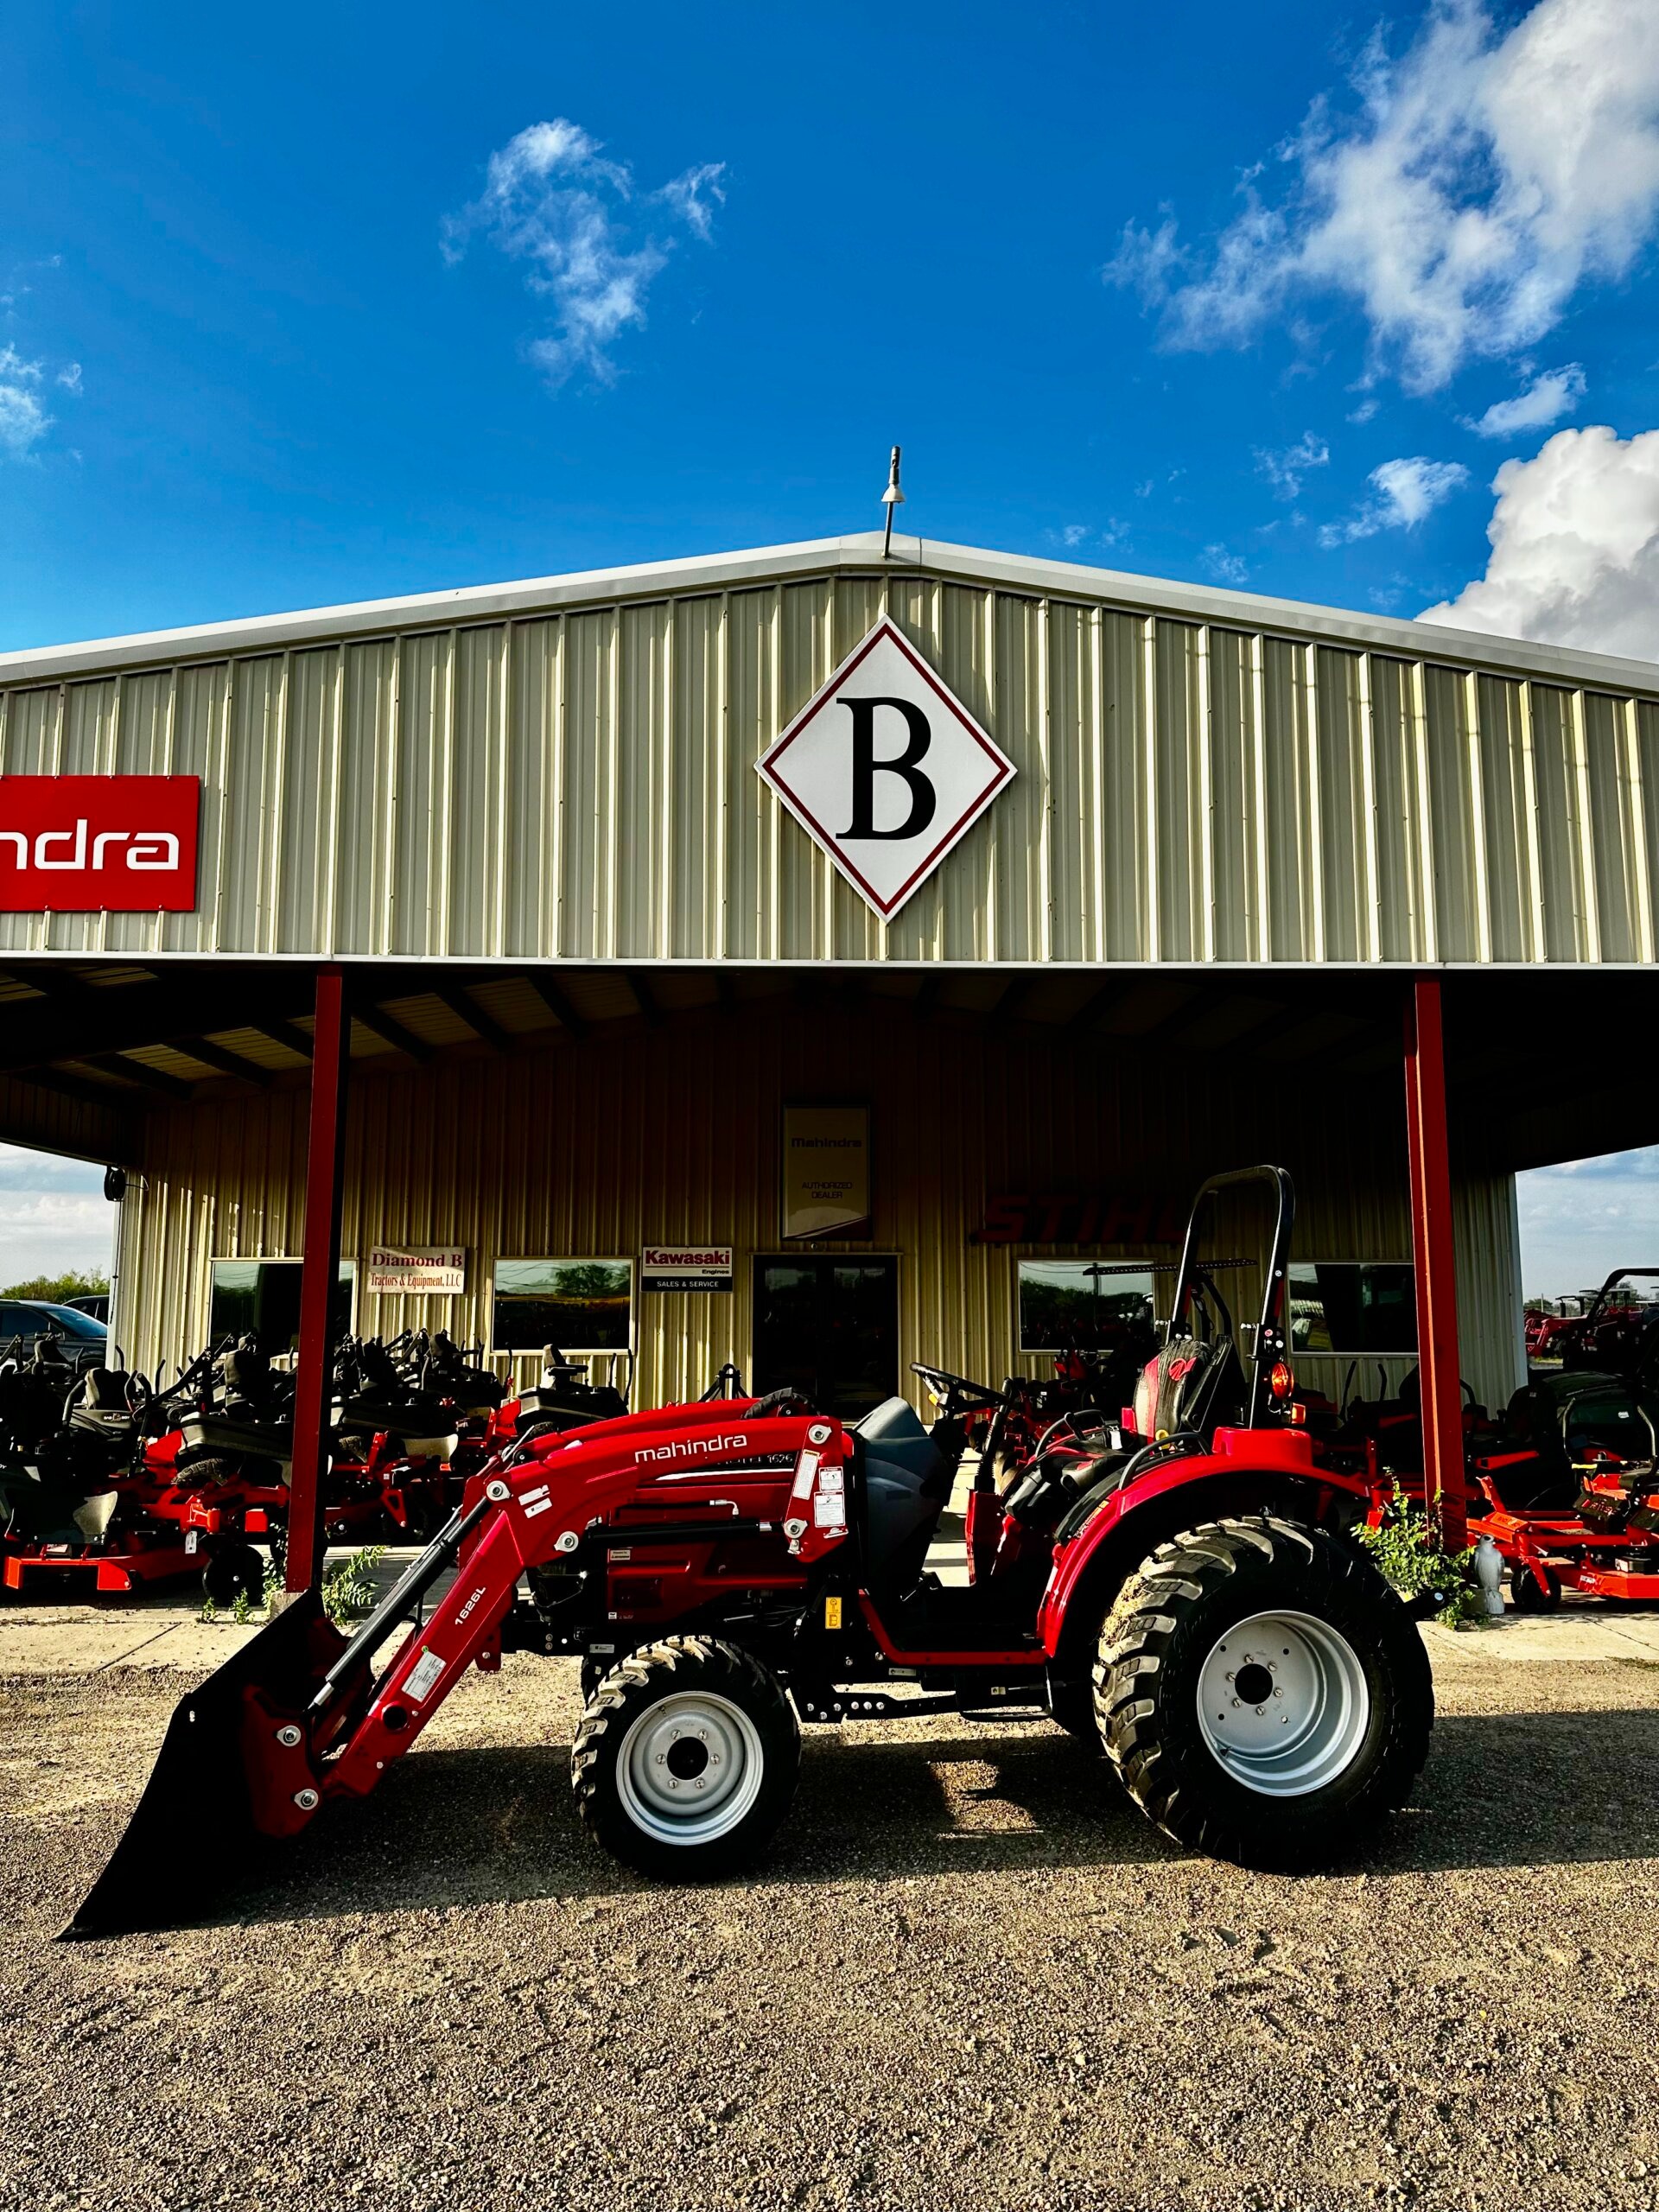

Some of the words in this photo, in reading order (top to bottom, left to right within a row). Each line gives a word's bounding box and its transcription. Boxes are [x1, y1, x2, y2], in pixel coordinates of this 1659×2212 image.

[836, 696, 937, 841] B
[801, 1181, 853, 1190] AUTHORIZED
[810, 1191, 843, 1199] DEALER
[372, 1253, 445, 1268] Diamond
[450, 1254, 462, 1268] B
[645, 1249, 730, 1265] Kawasaki
[371, 1272, 397, 1287] Tractors
[399, 1273, 405, 1287] &
[407, 1273, 445, 1289] Equipment,
[446, 1273, 461, 1287] LLC
[634, 1434, 747, 1464] mahindra
[454, 1586, 486, 1625] 1626L
